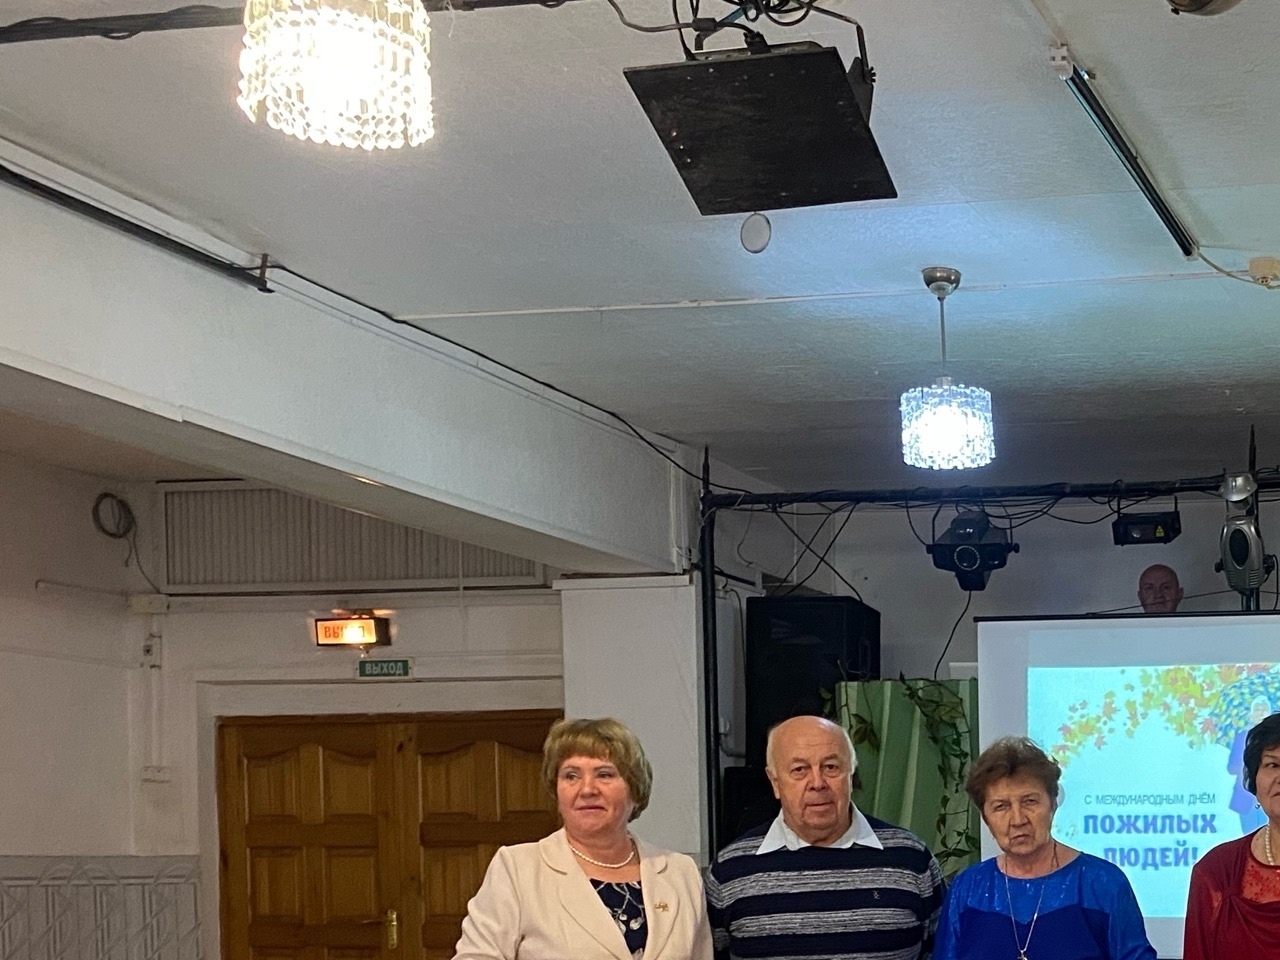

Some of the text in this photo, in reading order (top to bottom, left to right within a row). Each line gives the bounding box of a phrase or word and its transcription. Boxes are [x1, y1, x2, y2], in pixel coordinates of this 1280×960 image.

[365, 662, 404, 675] ВЫХОД
[1084, 792, 1216, 806] С МЕЖДУНАРОДНЫМ ДНЁМ
[1083, 813, 1217, 834] ПОЖИЛЫХ
[1103, 839, 1198, 871] ЛЮДЕЙ!
